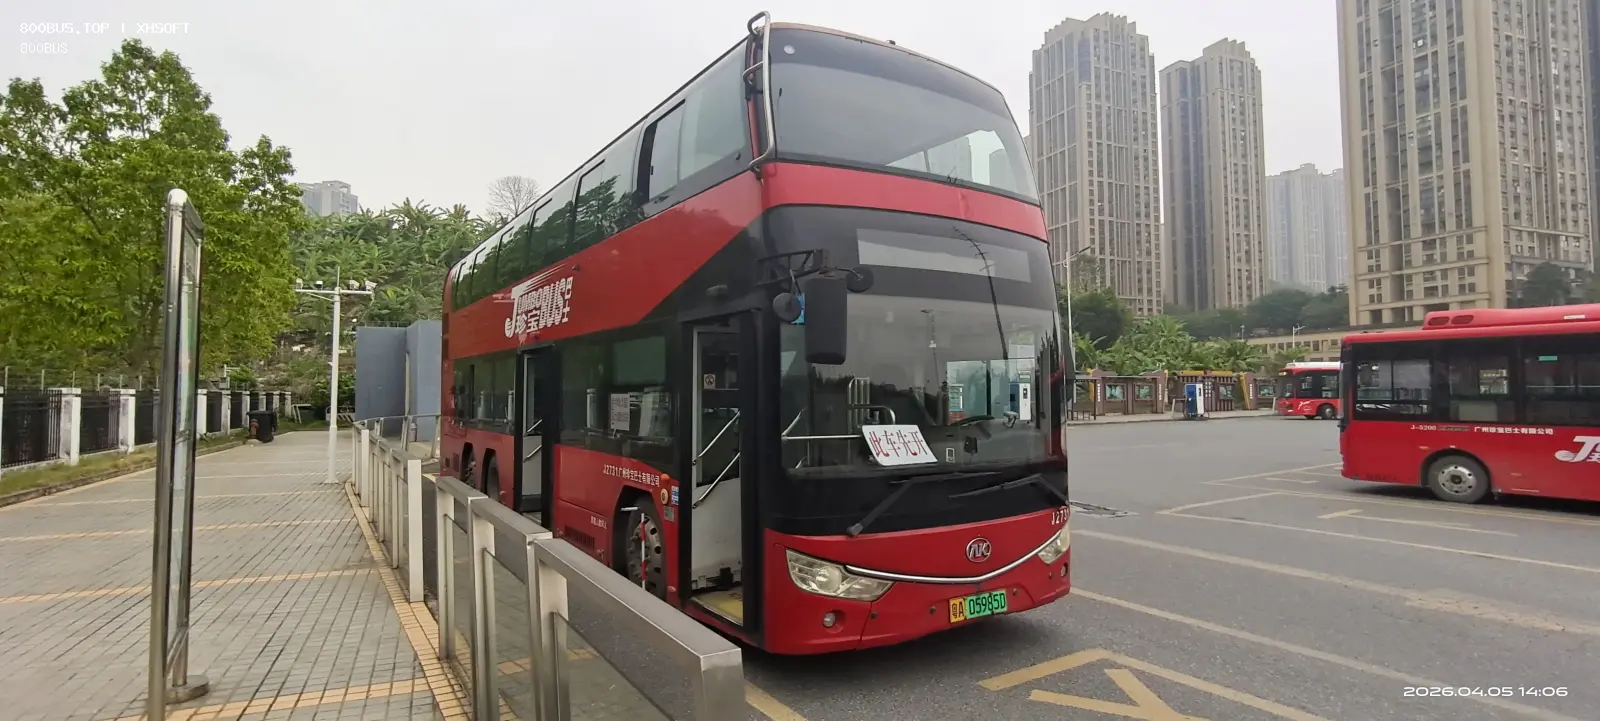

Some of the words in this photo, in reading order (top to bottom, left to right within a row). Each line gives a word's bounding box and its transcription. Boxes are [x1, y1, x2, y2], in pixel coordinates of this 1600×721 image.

[1474, 426, 1554, 435] 广州珍宝巴士有限公司
[869, 429, 928, 457] 此车先开
